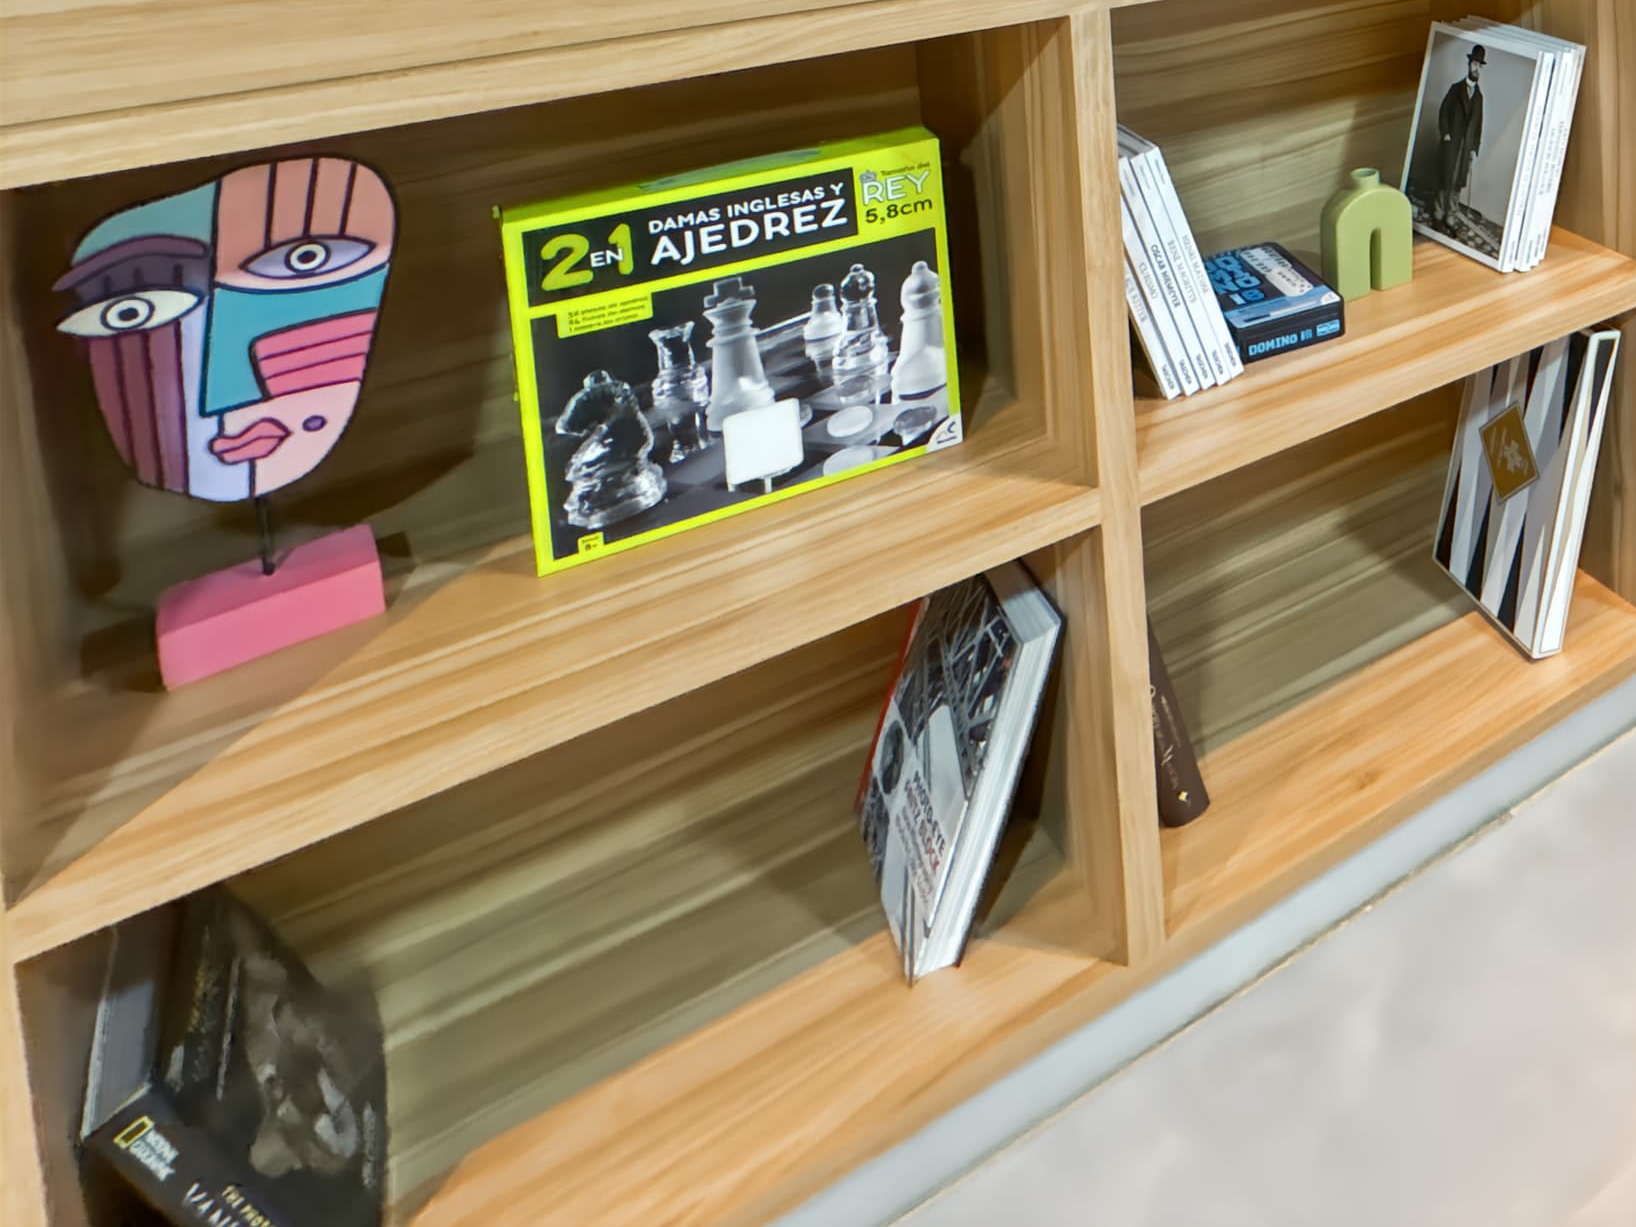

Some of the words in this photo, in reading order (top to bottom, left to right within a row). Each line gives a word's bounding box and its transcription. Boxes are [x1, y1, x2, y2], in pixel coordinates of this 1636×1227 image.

[649, 207, 720, 235] DAMAS
[727, 187, 826, 218] INGLESAS
[830, 182, 844, 197] Y
[863, 170, 931, 206] REY
[865, 198, 933, 225] 5,8cm
[540, 233, 594, 292] 2
[590, 248, 624, 268] EN
[607, 223, 634, 275] 1
[650, 198, 848, 266] AJEDREZ
[1150, 243, 1165, 270] OSCAR
[1160, 270, 1180, 308] NIEMEYER
[1248, 333, 1298, 356] DOMINO
